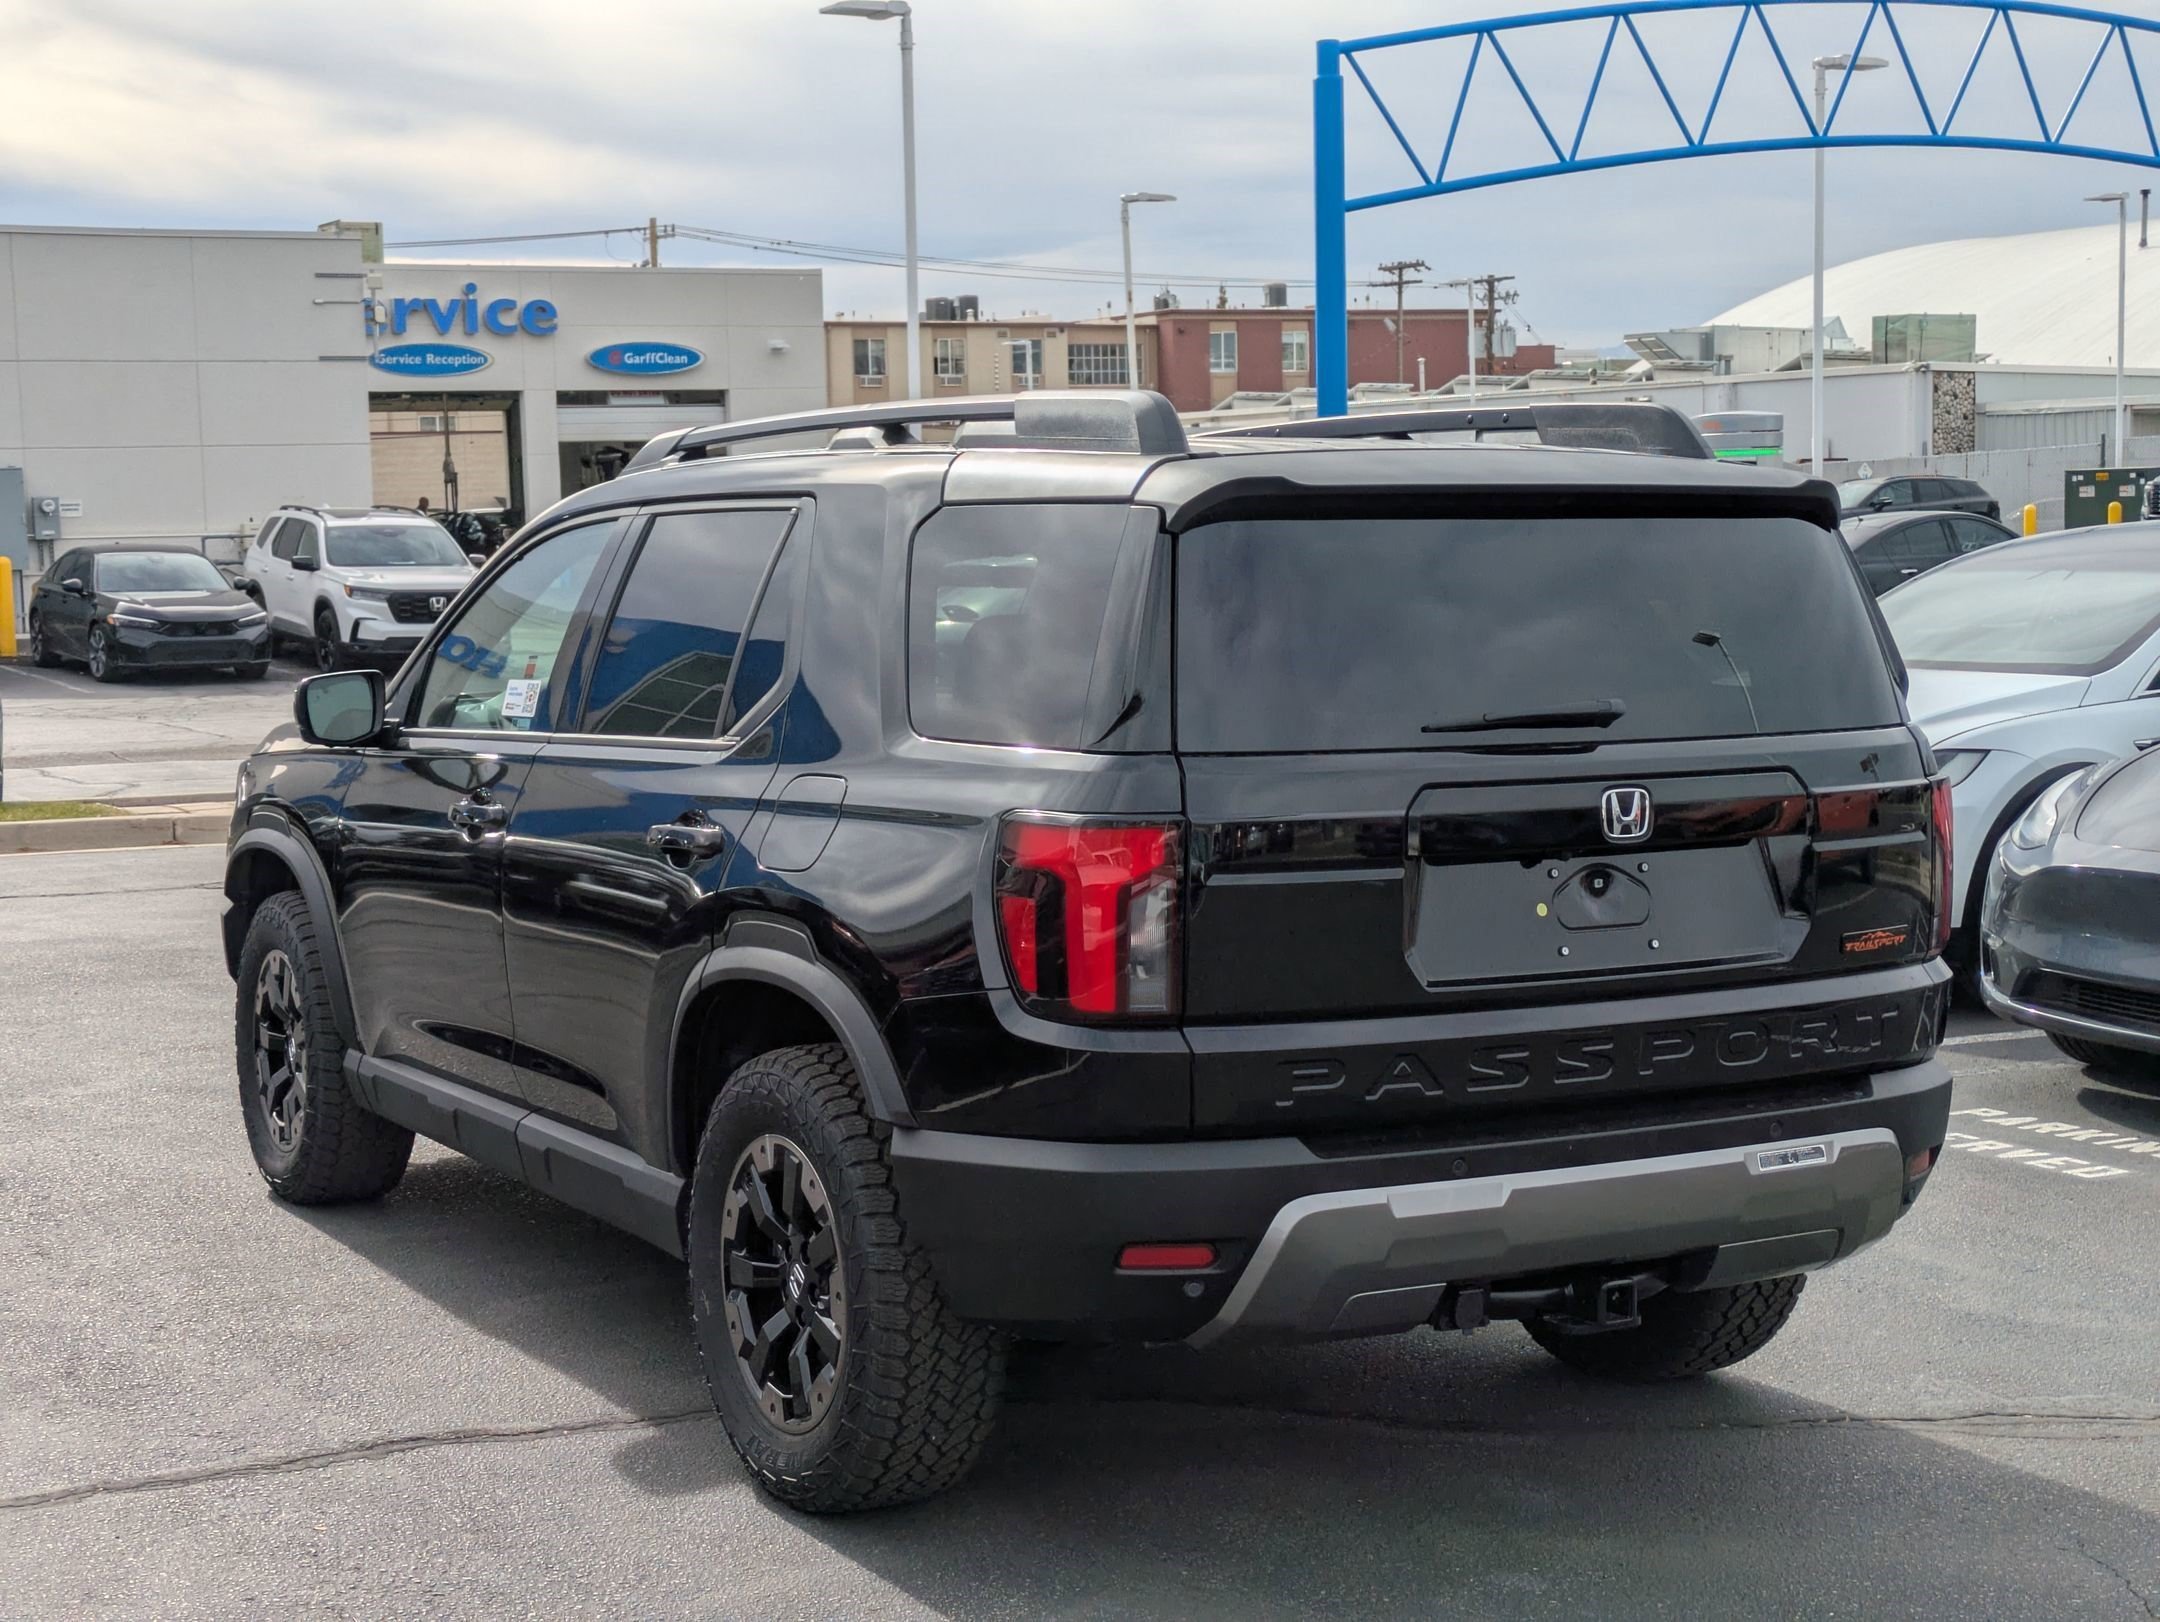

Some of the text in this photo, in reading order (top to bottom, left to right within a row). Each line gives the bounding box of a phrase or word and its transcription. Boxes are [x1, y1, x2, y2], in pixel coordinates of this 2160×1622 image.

[375, 353, 485, 367] Service Reception
[623, 352, 688, 364] GarffClean
[1845, 934, 1906, 952] TRAILSPORT
[1275, 1009, 1898, 1105] PASSPORT
[1949, 1107, 2160, 1158] PARKIN
